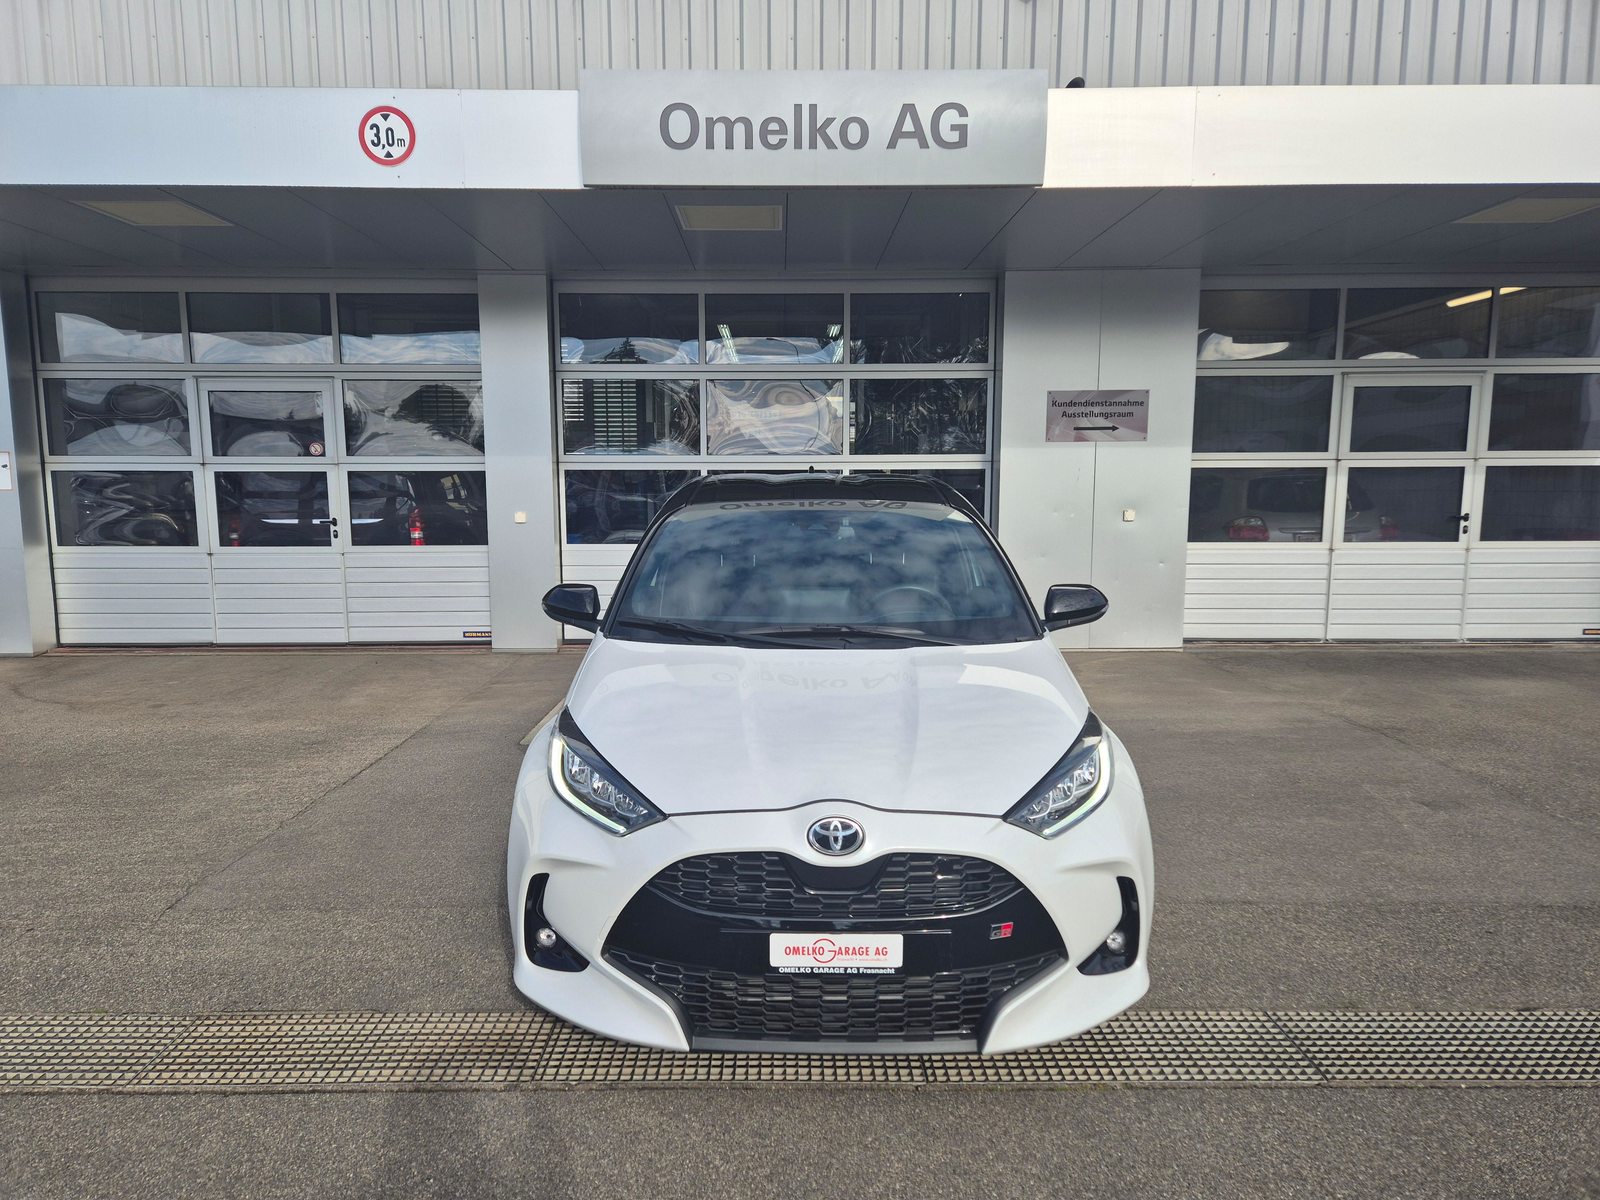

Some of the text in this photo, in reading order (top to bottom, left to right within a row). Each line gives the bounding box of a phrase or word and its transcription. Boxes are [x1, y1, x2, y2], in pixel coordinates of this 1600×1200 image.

[659, 102, 969, 151] Omelko AG
[1051, 399, 1145, 408] Kundendienstannahme
[1061, 410, 1134, 420] Ausstellungsraum
[784, 946, 825, 956] OMELKO
[874, 946, 888, 956] AG
